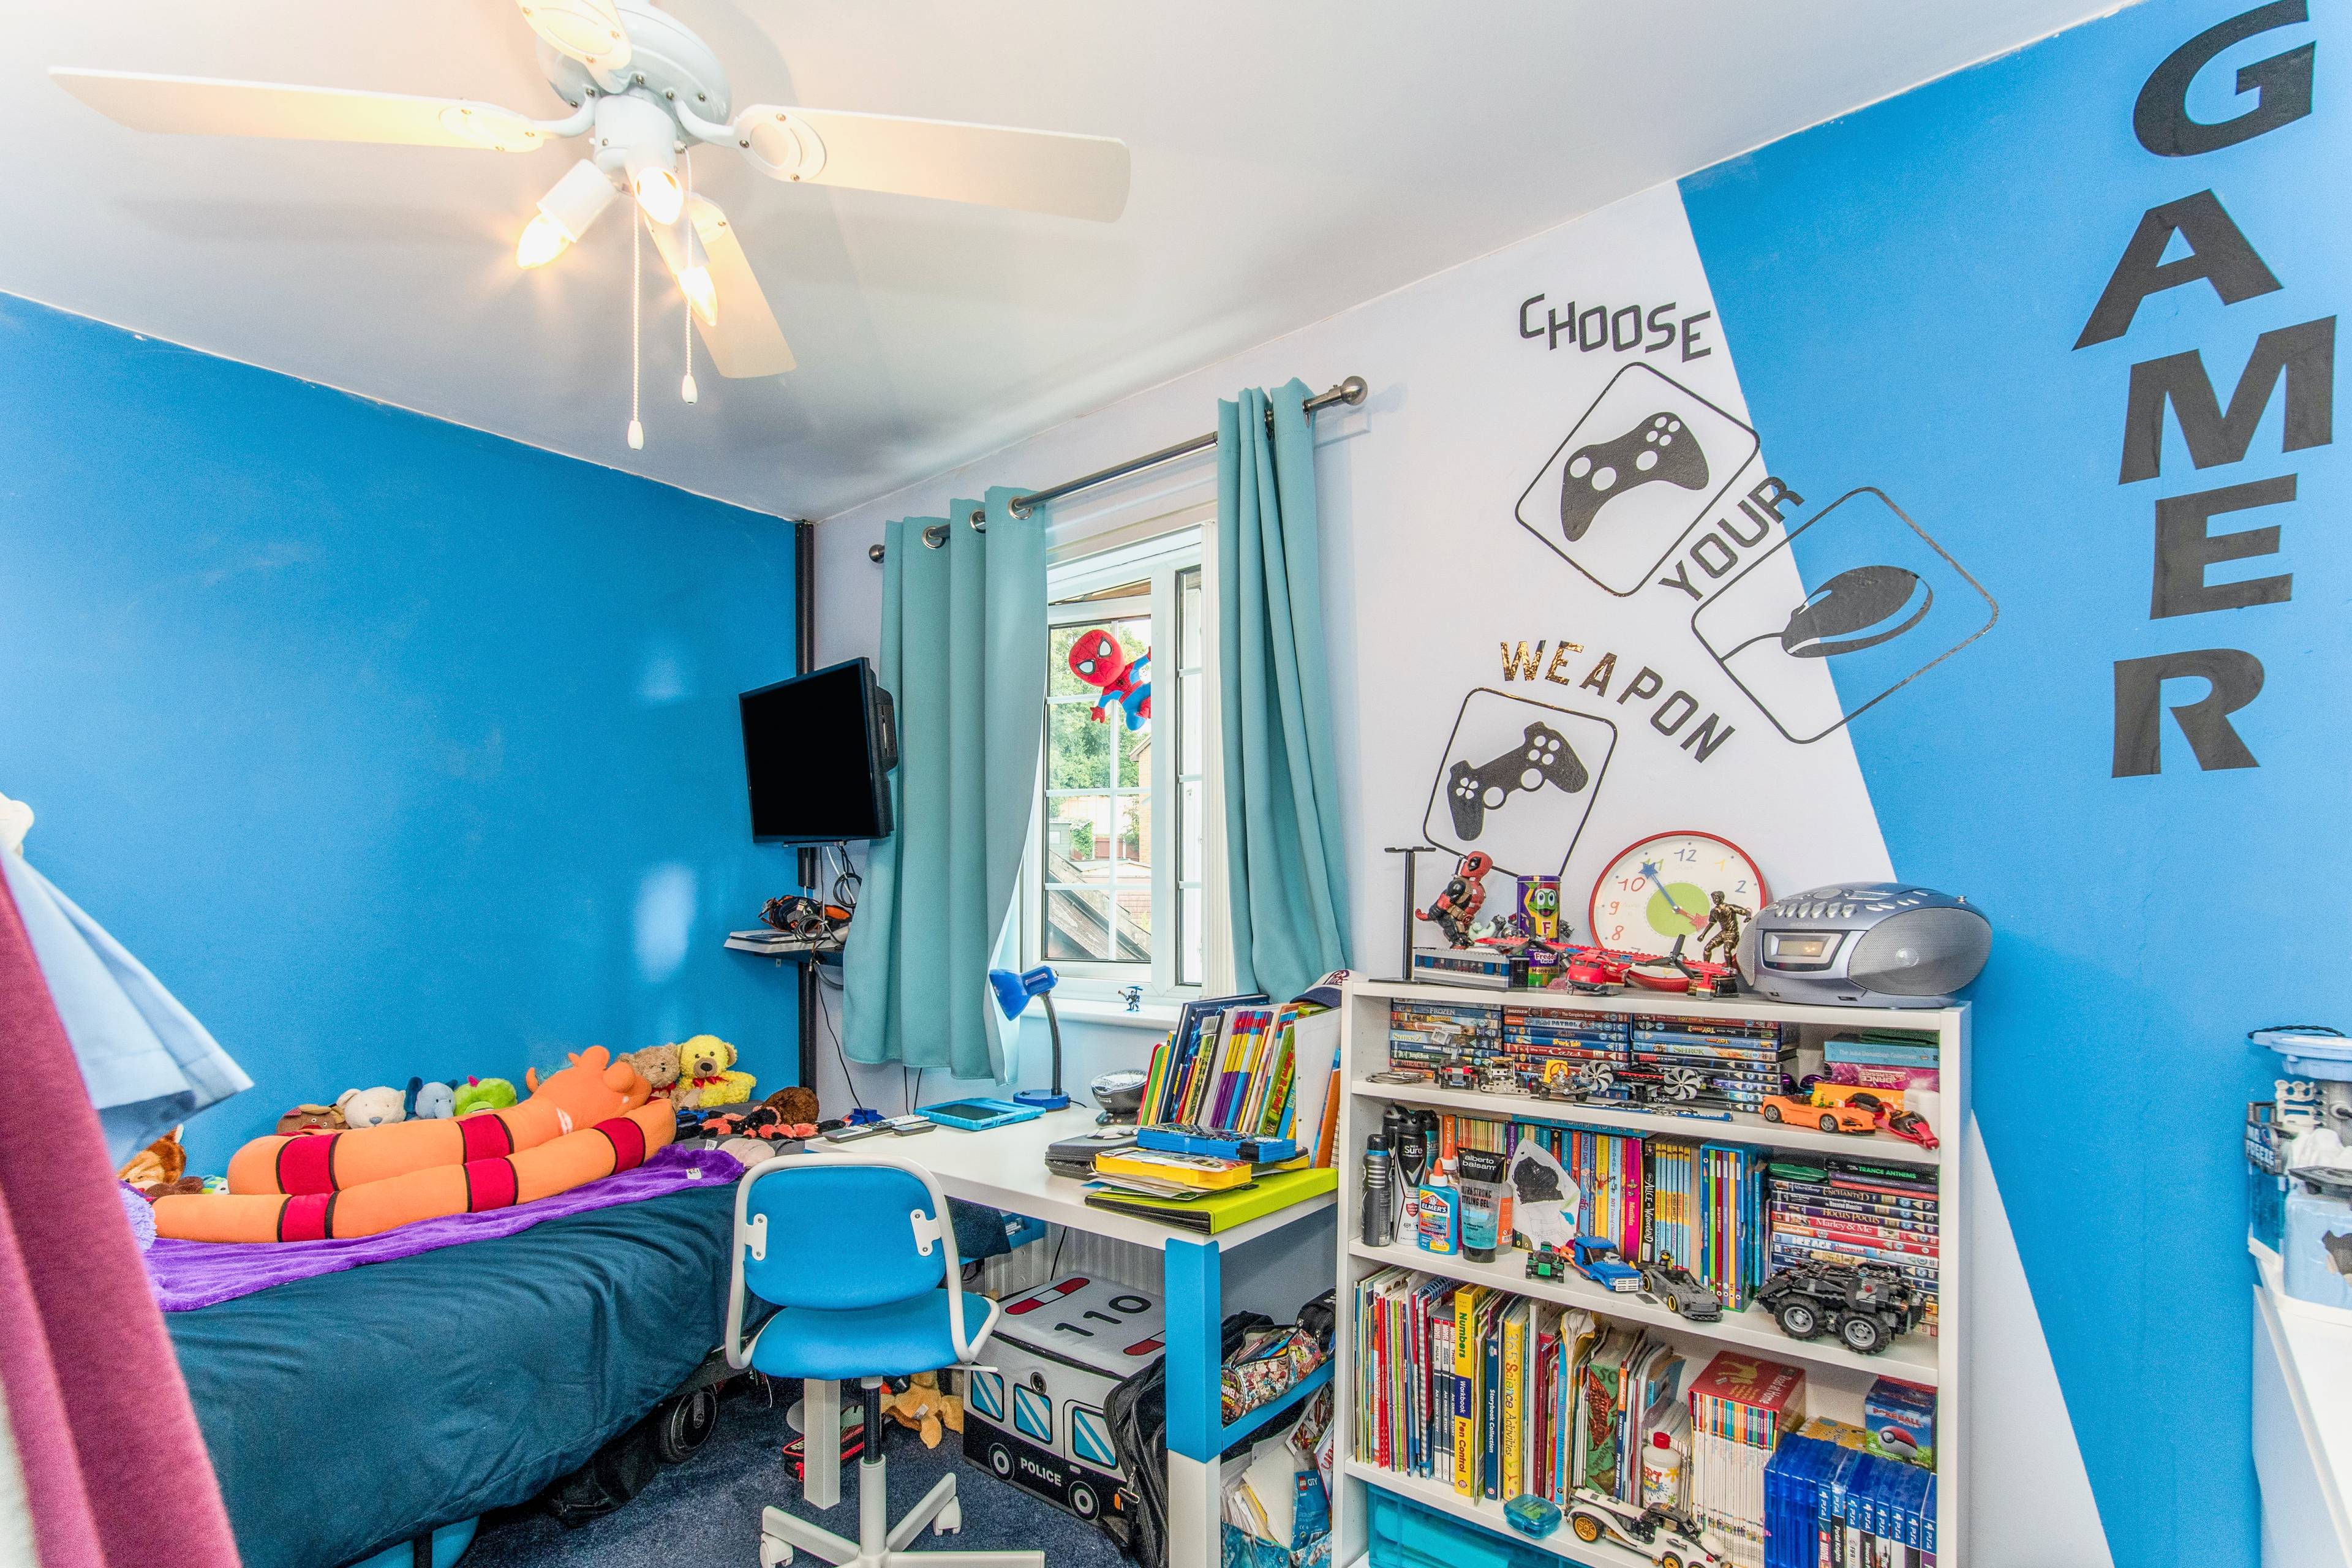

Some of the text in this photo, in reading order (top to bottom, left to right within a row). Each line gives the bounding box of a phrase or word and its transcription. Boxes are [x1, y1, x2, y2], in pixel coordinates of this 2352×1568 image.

[1520, 293, 1712, 363] CHOOSE
[2071, 0, 2337, 778] GAMER
[1657, 476, 1804, 601] YOUR
[1500, 639, 1736, 763] WEAPON
[1673, 848, 1697, 862] 12
[1714, 859, 1726, 872] 1
[1618, 876, 1646, 892] 10
[1735, 880, 1747, 894] 2
[1608, 901, 1620, 915] 9
[1542, 921, 1551, 934] F
[1611, 925, 1624, 941] 8
[1393, 1033, 1415, 1041] SHREK
[1553, 1038, 1569, 1047] Shark
[1548, 1047, 1581, 1057] Cars
[1673, 1045, 1705, 1055] SHREK
[1404, 1145, 1423, 1154] Sure
[1463, 1160, 1496, 1170] balsam
[1464, 1155, 1494, 1164] alberto
[1858, 1166, 1917, 1179] TRANCE ANTHEMS
[1473, 1187, 1492, 1199] STRONG
[1645, 1182, 1655, 1202] ALICE
[1823, 1187, 1869, 1201] ENCHANTED
[1422, 1202, 1447, 1213] ELMER'S
[1461, 1195, 1489, 1208] STYLING GEL
[1580, 1199, 1588, 1210] BFG
[1822, 1208, 1880, 1224] HOCUS POCUS
[1645, 1208, 1655, 1242] WONDERLAND
[1815, 1218, 1846, 1230] Marley
[1856, 1224, 1872, 1233] Me
[1792, 1237, 1811, 1246] ICE
[1812, 1240, 1833, 1250] AGE
[1054, 1295, 1152, 1336] 110
[1458, 1312, 1468, 1358] Numbers
[1505, 1362, 1519, 1408] Science
[1773, 1374, 1792, 1388] Read
[1222, 1395, 1235, 1407] MICS
[1758, 1388, 1782, 1404] Home
[1504, 1411, 1517, 1457] Activities
[1020, 1457, 1062, 1487] POLICE
[1308, 1478, 1317, 1487] CITY
